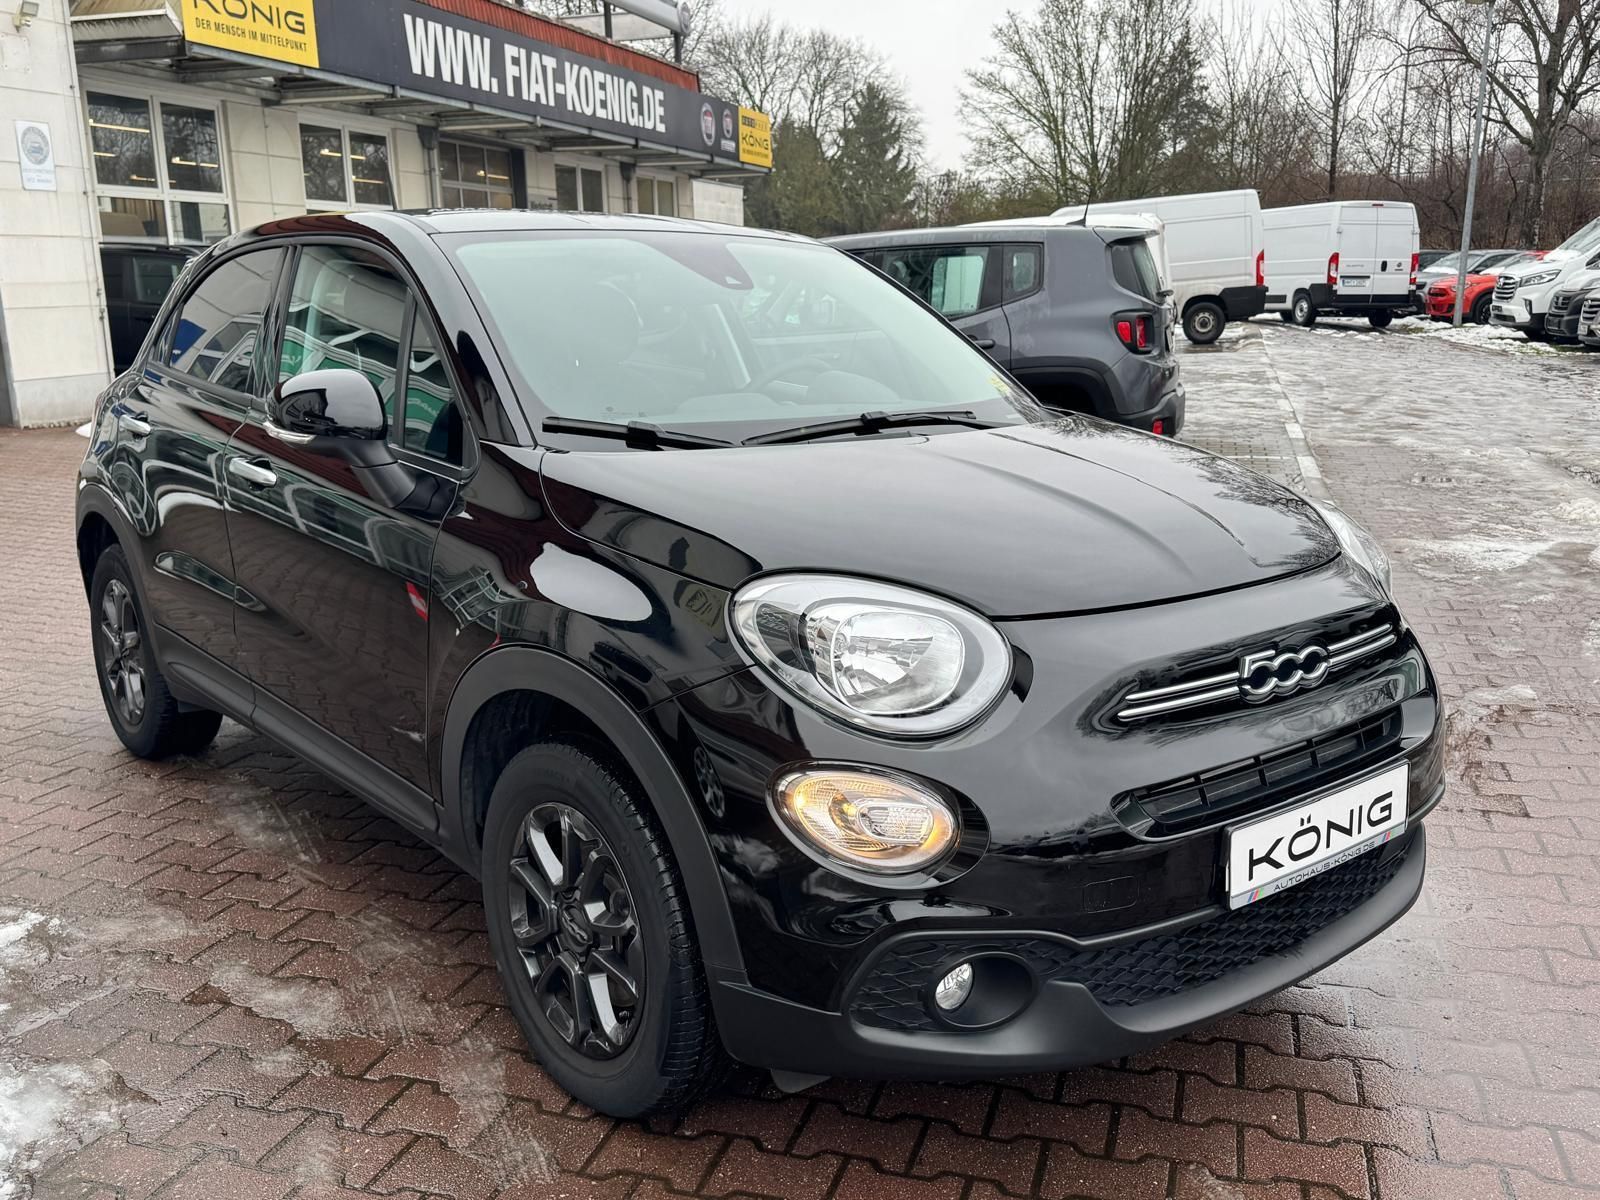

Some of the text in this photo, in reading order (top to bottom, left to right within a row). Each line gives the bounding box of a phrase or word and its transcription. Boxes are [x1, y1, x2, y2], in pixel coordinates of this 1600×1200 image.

[195, 17, 307, 52] DER MENSCH IM MITTELPUNKT
[504, 43, 666, 133] FIAT-KOENIG.DE
[1243, 645, 1330, 696] 500
[1248, 790, 1393, 881] KÖNIG
